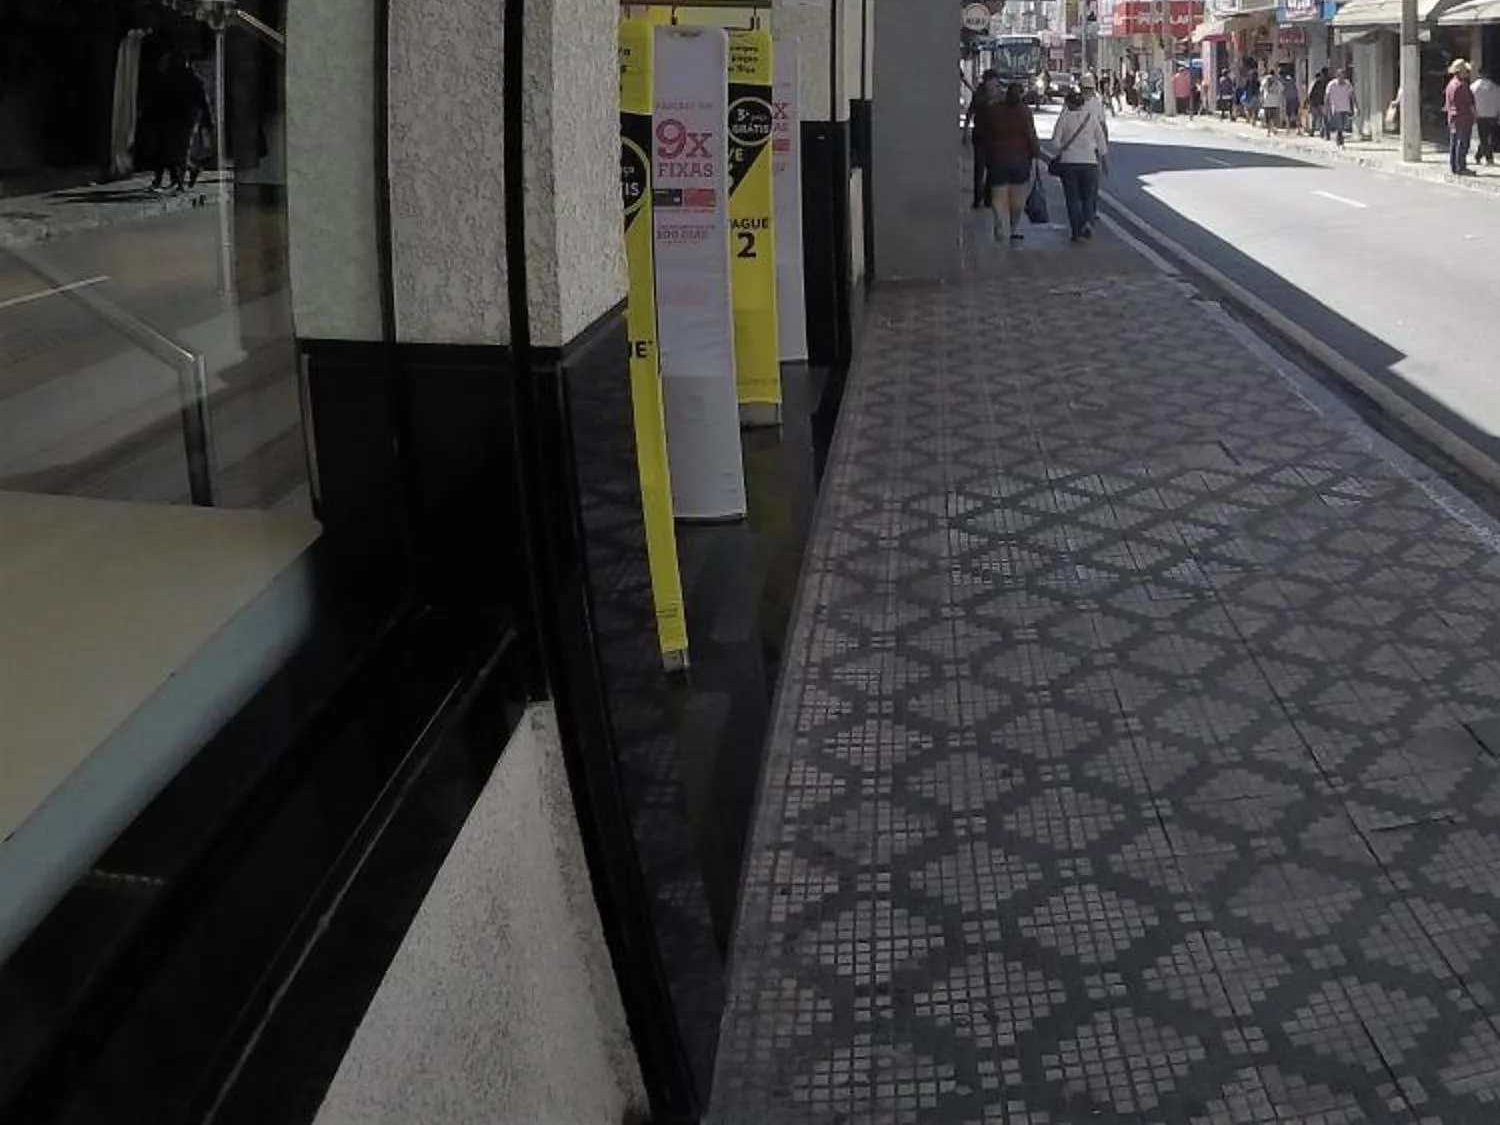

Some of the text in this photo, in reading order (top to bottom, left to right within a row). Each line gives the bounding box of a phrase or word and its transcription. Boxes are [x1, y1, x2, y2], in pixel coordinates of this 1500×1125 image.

[658, 162, 713, 177] FIXAS
[730, 218, 769, 229] AGUE
[736, 232, 757, 258] 2
